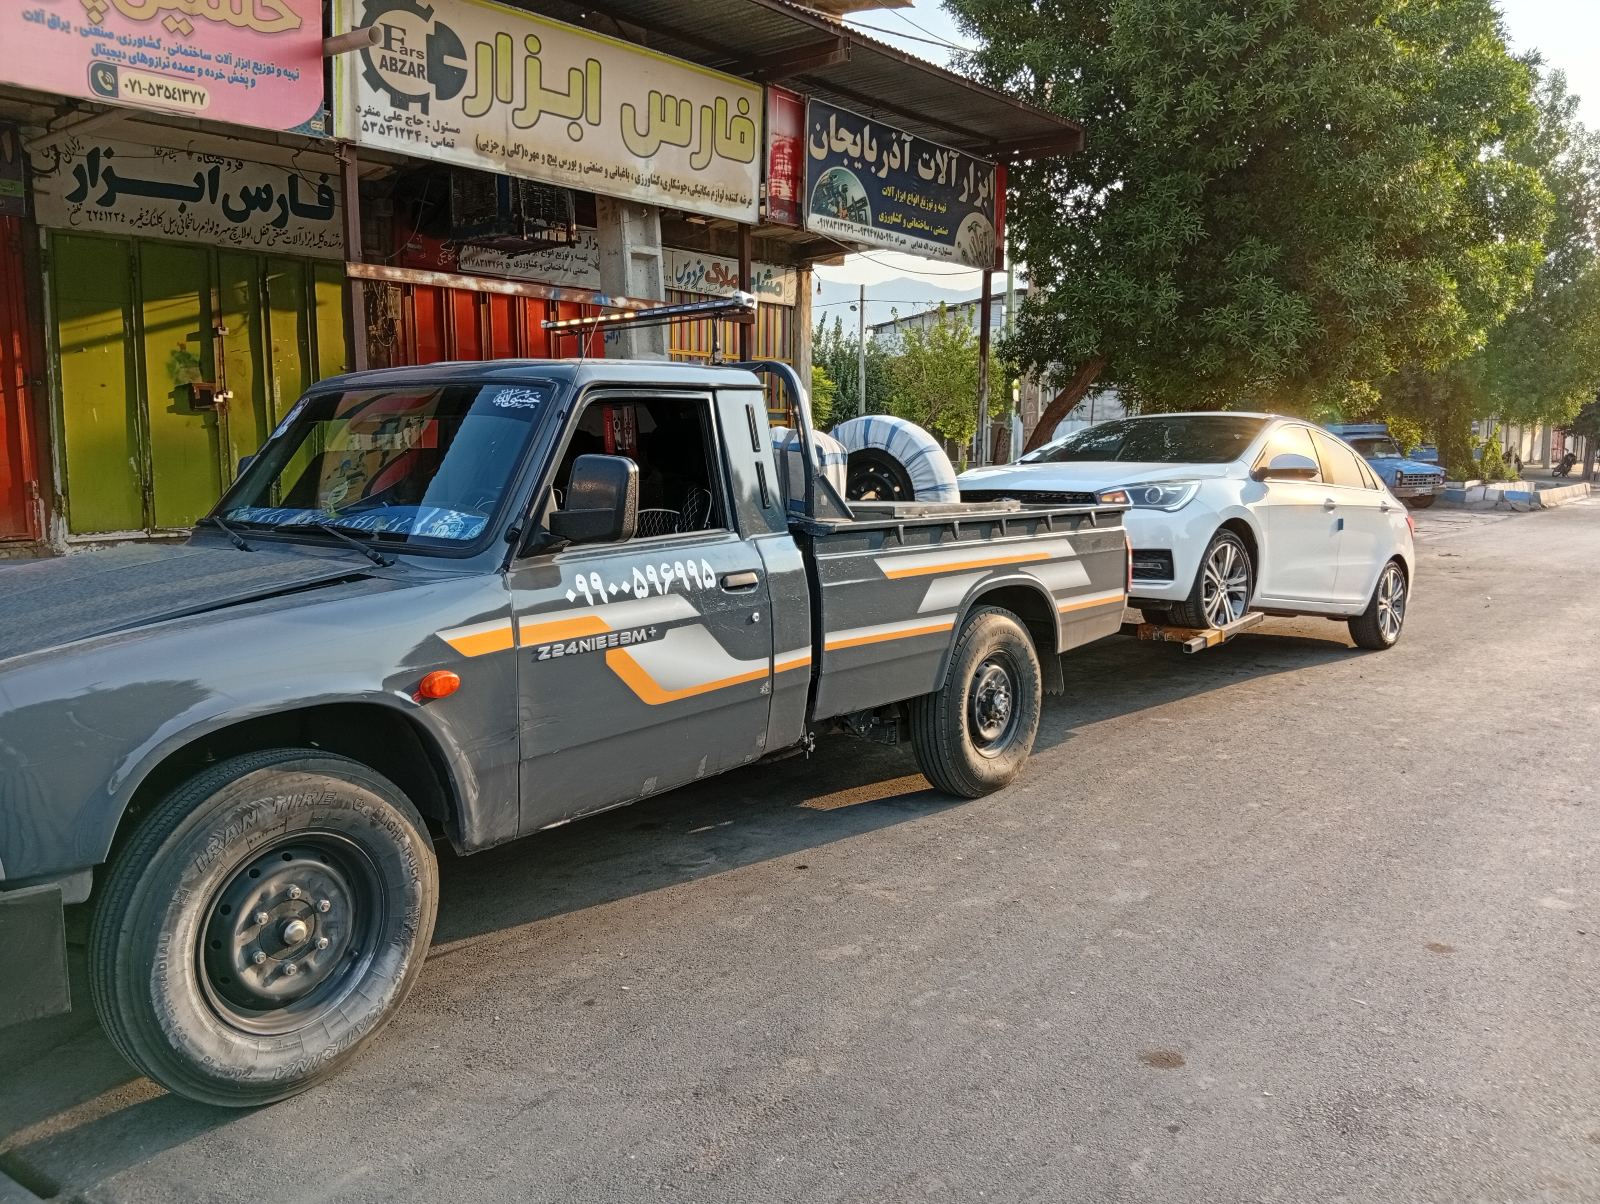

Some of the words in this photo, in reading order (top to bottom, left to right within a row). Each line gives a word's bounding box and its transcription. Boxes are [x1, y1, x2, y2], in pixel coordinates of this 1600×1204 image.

[379, 22, 425, 60] Fars
[91, 43, 126, 62] دیجیتال
[215, 52, 232, 66] آلات
[172, 62, 196, 74] عمده
[198, 68, 204, 78] و
[204, 68, 226, 80] خرده
[234, 58, 250, 72] ابزار
[252, 62, 275, 76] توزیع
[276, 70, 282, 78] و
[283, 68, 300, 80] تهیه
[379, 54, 426, 80] ABZAR
[228, 71, 249, 90] پخش
[250, 78, 256, 88] و
[461, 32, 602, 142] ابزار
[355, 104, 381, 118] منفرد
[383, 110, 403, 122] علی
[405, 114, 424, 127] حاج
[361, 120, 422, 142] ۵۳۵۴۱۲۳۴
[620, 89, 756, 171] فارس
[809, 112, 914, 180] آذربایجان
[917, 149, 960, 188] آلات
[64, 146, 220, 214] ابزار
[956, 161, 995, 207] ابزار
[222, 172, 335, 228] فارس
[566, 558, 717, 606] ۰۹۹۰۰۵۹۶۹۹۵
[191, 807, 261, 874] IRAN
[273, 790, 338, 816] TIRE
